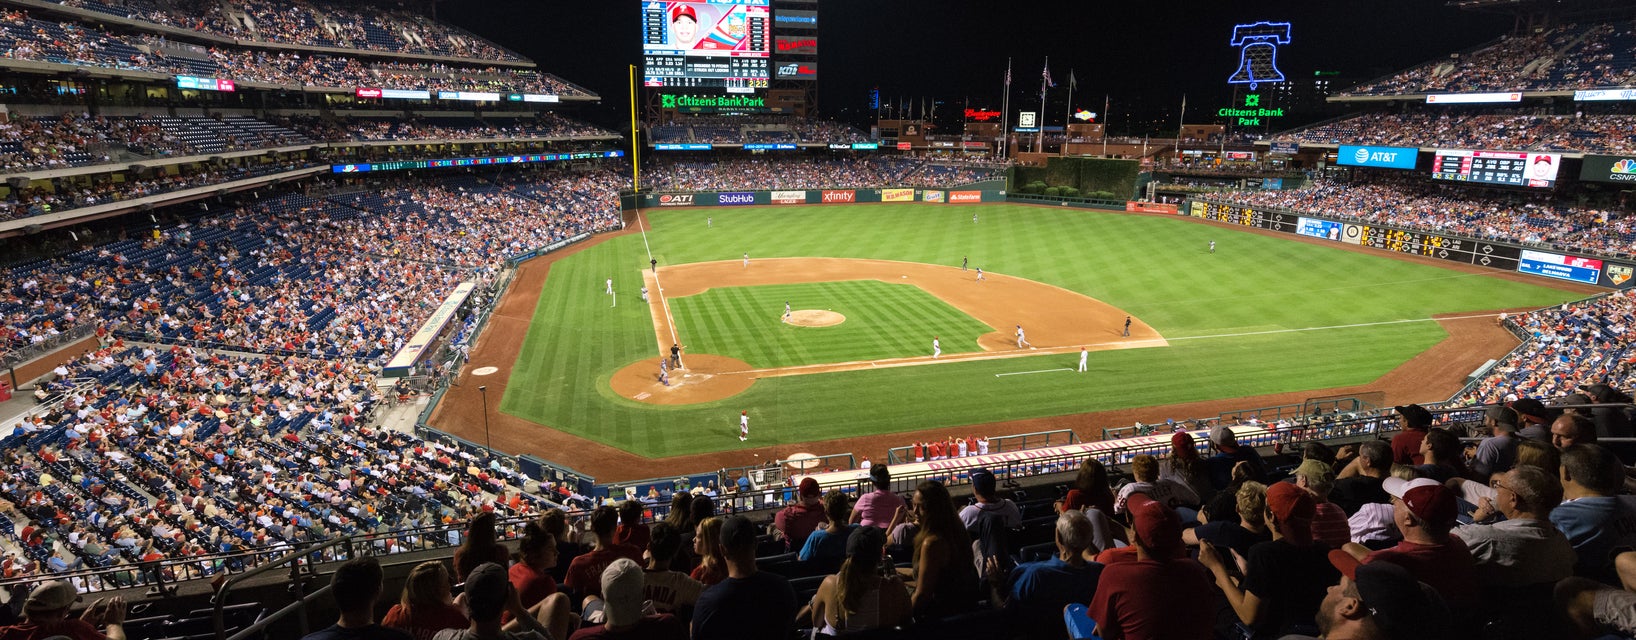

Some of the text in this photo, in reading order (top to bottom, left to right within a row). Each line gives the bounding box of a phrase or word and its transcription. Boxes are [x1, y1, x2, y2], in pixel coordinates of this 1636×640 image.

[677, 97, 765, 107] Citizens Bank Park
[1219, 108, 1284, 117] Citizens Bank
[1238, 118, 1260, 126] Park
[1370, 152, 1397, 162] AT&T
[719, 194, 754, 203] StubHub
[824, 191, 853, 202] xfinity
[1543, 264, 1572, 272] LAKEWOOD
[1542, 269, 1570, 277] DELMARVA
[1080, 437, 1158, 454] PHILLIES
[643, 584, 677, 605] ANDA
